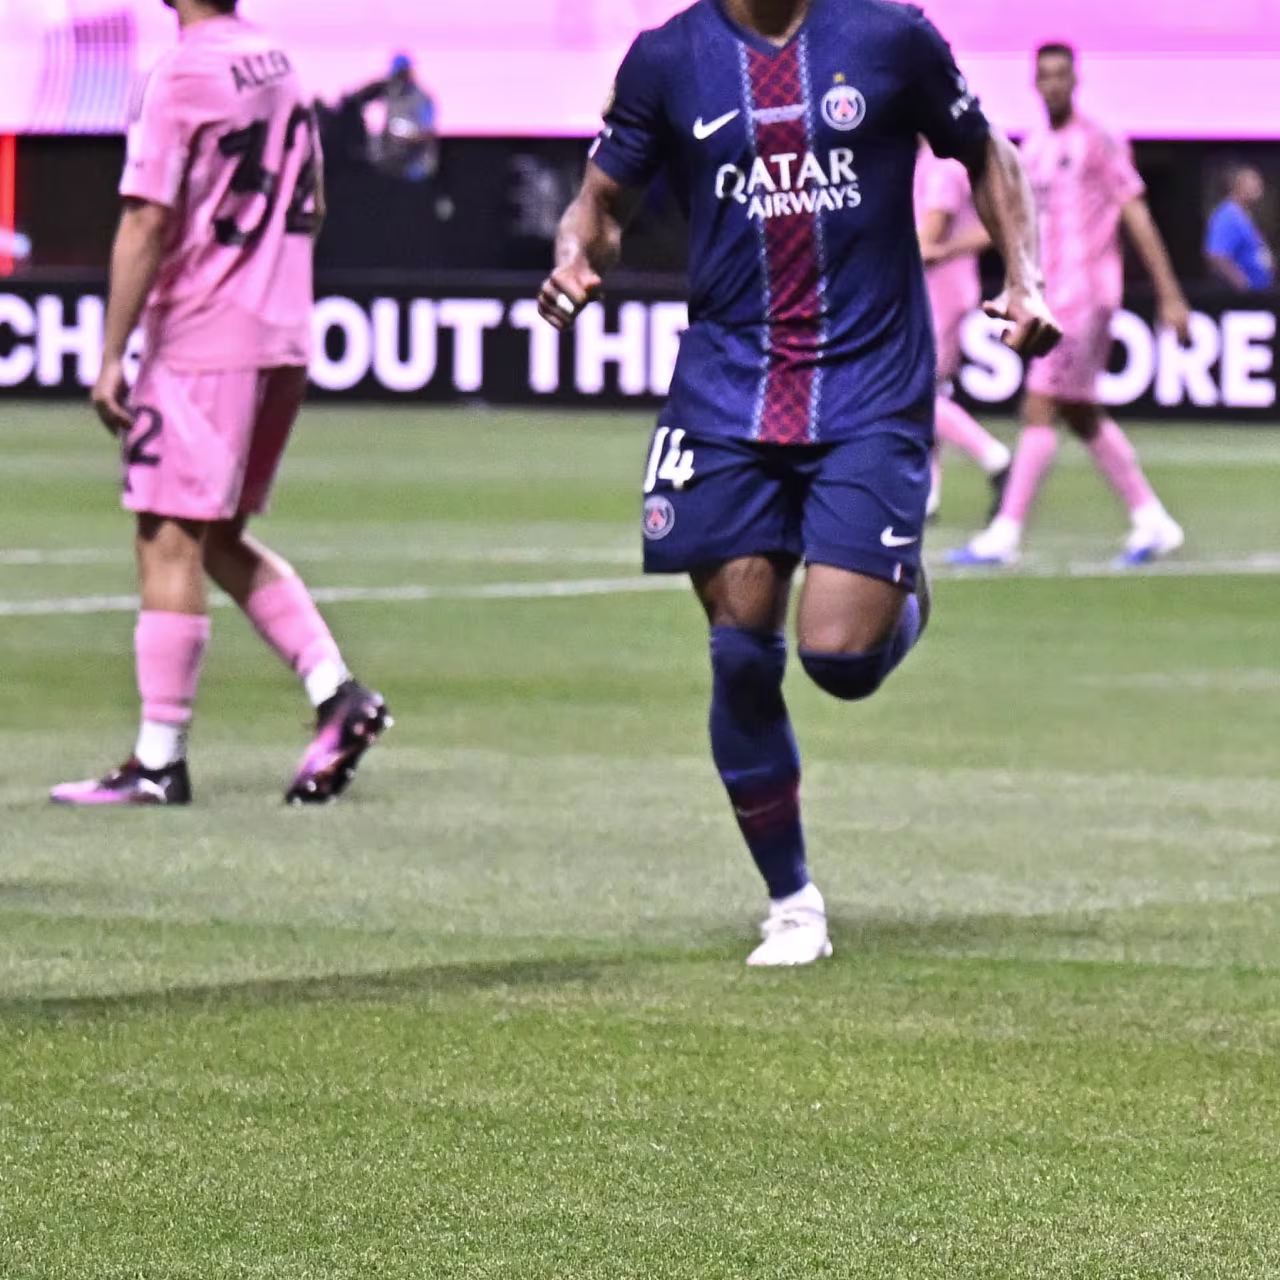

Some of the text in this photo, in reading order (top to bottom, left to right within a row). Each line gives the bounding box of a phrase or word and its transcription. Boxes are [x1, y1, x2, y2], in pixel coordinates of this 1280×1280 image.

[715, 147, 858, 205] QATAR
[746, 183, 862, 220] AIRWAYS
[306, 296, 503, 393] OUT
[959, 308, 1277, 407] SORE
[643, 426, 695, 494] 14
